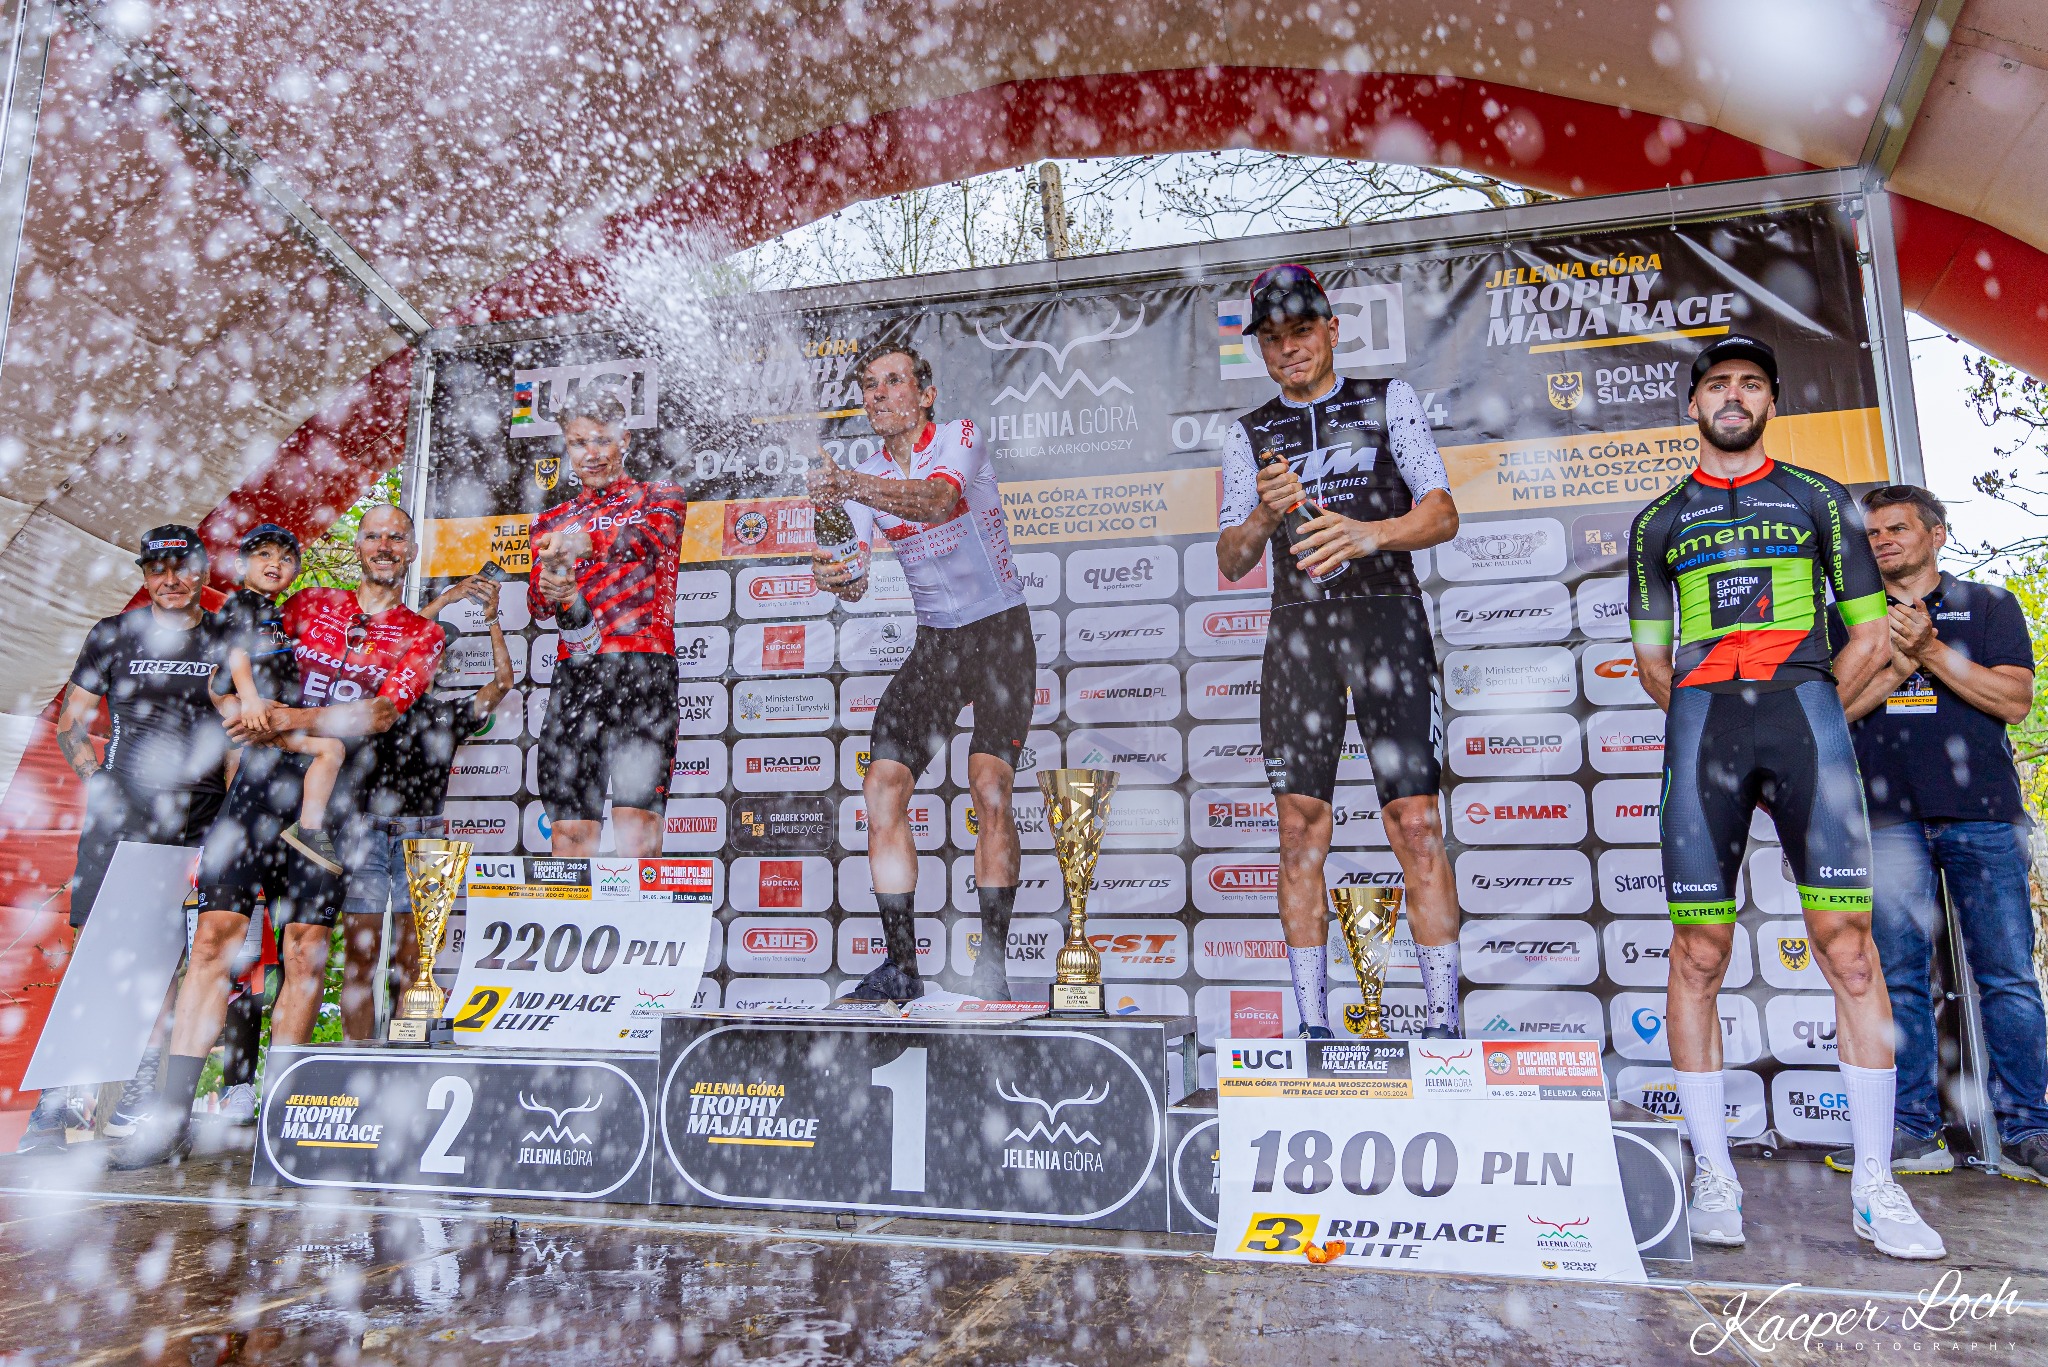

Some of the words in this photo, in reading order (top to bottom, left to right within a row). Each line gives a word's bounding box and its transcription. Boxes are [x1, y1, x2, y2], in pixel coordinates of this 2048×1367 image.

[1486, 262, 1585, 289] JELENIA
[1591, 253, 1662, 277] GÓRA
[1486, 272, 1660, 318] TROPHY
[1487, 307, 1608, 347] MAJA
[1618, 293, 1735, 333] RACE
[1596, 362, 1679, 385] DOLNY
[1597, 381, 1676, 404] ŚLĄSK
[988, 410, 1074, 443] JELENIA
[1080, 405, 1138, 434] GÓRA
[1339, 420, 1380, 429] VICTORIA
[996, 446, 1045, 459] STOLICA
[1049, 439, 1133, 455] KARKONOSZY
[1499, 448, 1584, 467] JELENIA
[1589, 442, 1650, 459] GÓRA
[1497, 467, 1555, 484] MAJA
[1037, 487, 1088, 503] GÓRA
[1092, 483, 1164, 500] TROPHY
[1513, 486, 1557, 500] MTB
[1563, 480, 1618, 497] RACE
[1625, 476, 1660, 491] UCI
[1013, 499, 1167, 521] WŁOSZCZOWSKA
[589, 510, 643, 532] JBG2
[1014, 520, 1059, 537] RACE
[1065, 520, 1092, 533] UCI
[1098, 518, 1134, 532] XCO
[1139, 516, 1156, 528] C1
[1636, 506, 1659, 551] EXTREM
[1781, 465, 1829, 491] AMENITY
[1828, 500, 1842, 548] EXTREM
[1835, 553, 1844, 591] SPORT
[491, 539, 530, 552] MAJA
[1666, 520, 1812, 564] amenity
[499, 554, 529, 565] MTB
[1676, 546, 1747, 571] wellness
[1765, 544, 1798, 554] spa
[1084, 558, 1154, 590] quest
[759, 579, 810, 595] ABUS
[1103, 582, 1142, 591] sportswear
[1638, 560, 1650, 611] AMENITY
[1717, 576, 1759, 589] EXTREM
[1717, 586, 1751, 598] SPORT
[1718, 595, 1740, 608] ZLÍN
[765, 643, 802, 651] SUDECKA
[1486, 664, 1548, 675] Ministerstwo
[1486, 676, 1518, 687] Sportu
[1528, 674, 1570, 686] Turystyki
[765, 694, 814, 702] Ministerstwo
[765, 705, 788, 713] Sportu
[797, 703, 829, 713] Turystyki
[1489, 734, 1562, 746] RADIO
[1112, 752, 1167, 763] INPEAK
[1490, 746, 1562, 754] WROCŁAW
[764, 756, 821, 766] RADIO
[764, 765, 820, 773] WROCŁAW
[770, 813, 799, 822] GRABEK
[800, 813, 823, 822] SPORT
[1494, 804, 1568, 820] ELMAR
[452, 819, 506, 829] RADIO
[668, 817, 717, 833] SPORTOWE
[484, 865, 515, 878] UCI
[534, 865, 564, 873] TROPHY
[661, 866, 686, 877] PUCHAR
[688, 867, 711, 877] POLSKI
[761, 879, 799, 887] SUDECKA
[1677, 907, 1725, 917] EXTREM
[475, 921, 621, 975] 2200
[623, 940, 686, 967] PLN
[753, 933, 807, 948] ABUS
[1204, 941, 1242, 957] SŁOWO
[752, 955, 771, 963] Security
[784, 955, 806, 963] Germany
[454, 990, 500, 1030] 2
[510, 992, 543, 1010] ND
[546, 993, 621, 1013] PLACE
[1234, 1012, 1279, 1020] SUDECKA
[493, 1013, 559, 1031] ELITE
[1520, 1022, 1586, 1033] INPEAK
[1350, 1044, 1370, 1052] GÓRA
[1374, 1048, 1404, 1058] 2024
[1244, 1050, 1293, 1070] UCI
[1322, 1052, 1369, 1061] TROPHY
[1517, 1052, 1557, 1066] PUCHAR
[1559, 1052, 1597, 1066] POLSKI
[1322, 1061, 1356, 1070] MAJA
[1358, 1061, 1389, 1070] RACE
[1526, 1067, 1567, 1076] KOLARSTWIE
[690, 1082, 744, 1095] JELENIA
[747, 1081, 785, 1096] GÓRA
[1255, 1079, 1277, 1087] GÓRA
[1425, 1078, 1452, 1087] JELENIA
[286, 1094, 329, 1107] JELENIA
[330, 1093, 359, 1107] GÓRA
[1543, 1089, 1577, 1097] JELENIA
[1582, 1088, 1601, 1097] GÓRA
[690, 1095, 784, 1117] TROPHY
[284, 1106, 358, 1123] TROPHY
[871, 1047, 928, 1192] 1
[280, 1121, 335, 1139] MAJA
[335, 1124, 384, 1142] RACE
[419, 1075, 474, 1175] 2
[687, 1115, 753, 1136] MAJA
[756, 1118, 819, 1139] RACE
[518, 1147, 562, 1166] JELENIA
[563, 1147, 593, 1167] GÓRA
[1001, 1148, 1060, 1171] JELENIA
[1062, 1148, 1104, 1174] GÓRA
[1250, 1129, 1459, 1197] 1800
[1481, 1151, 1574, 1187] PLN
[1246, 1217, 1305, 1252] 3
[1327, 1219, 1379, 1238] RD
[1389, 1221, 1506, 1243] PLACE
